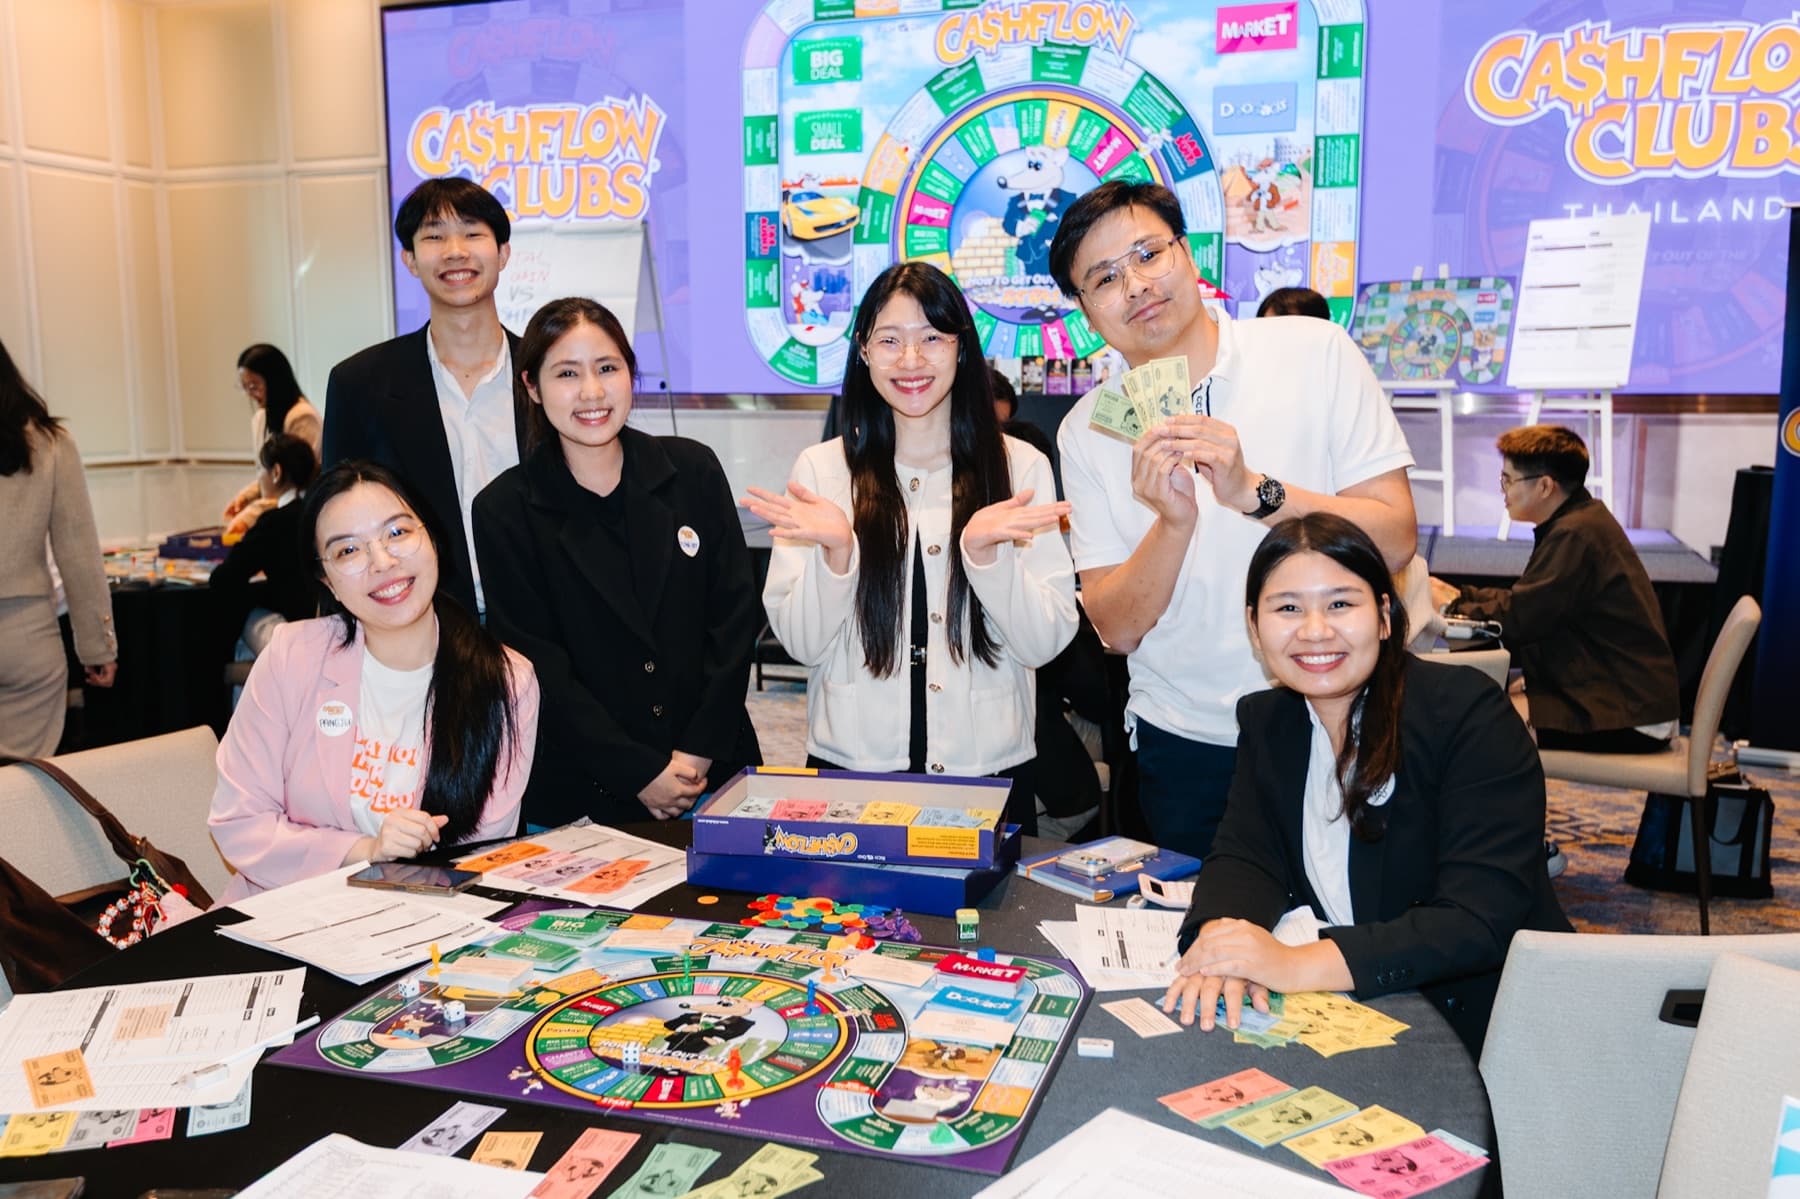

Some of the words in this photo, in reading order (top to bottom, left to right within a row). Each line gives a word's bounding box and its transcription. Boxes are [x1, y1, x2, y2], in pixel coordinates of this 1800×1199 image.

[1221, 13, 1292, 39] MARKET
[810, 49, 844, 68] BIG
[810, 67, 844, 80] DEAL
[810, 138, 845, 150] DEAL
[1563, 197, 1787, 224] THAILAND
[552, 920, 586, 928] BIG
[953, 962, 1020, 978] MARKET
